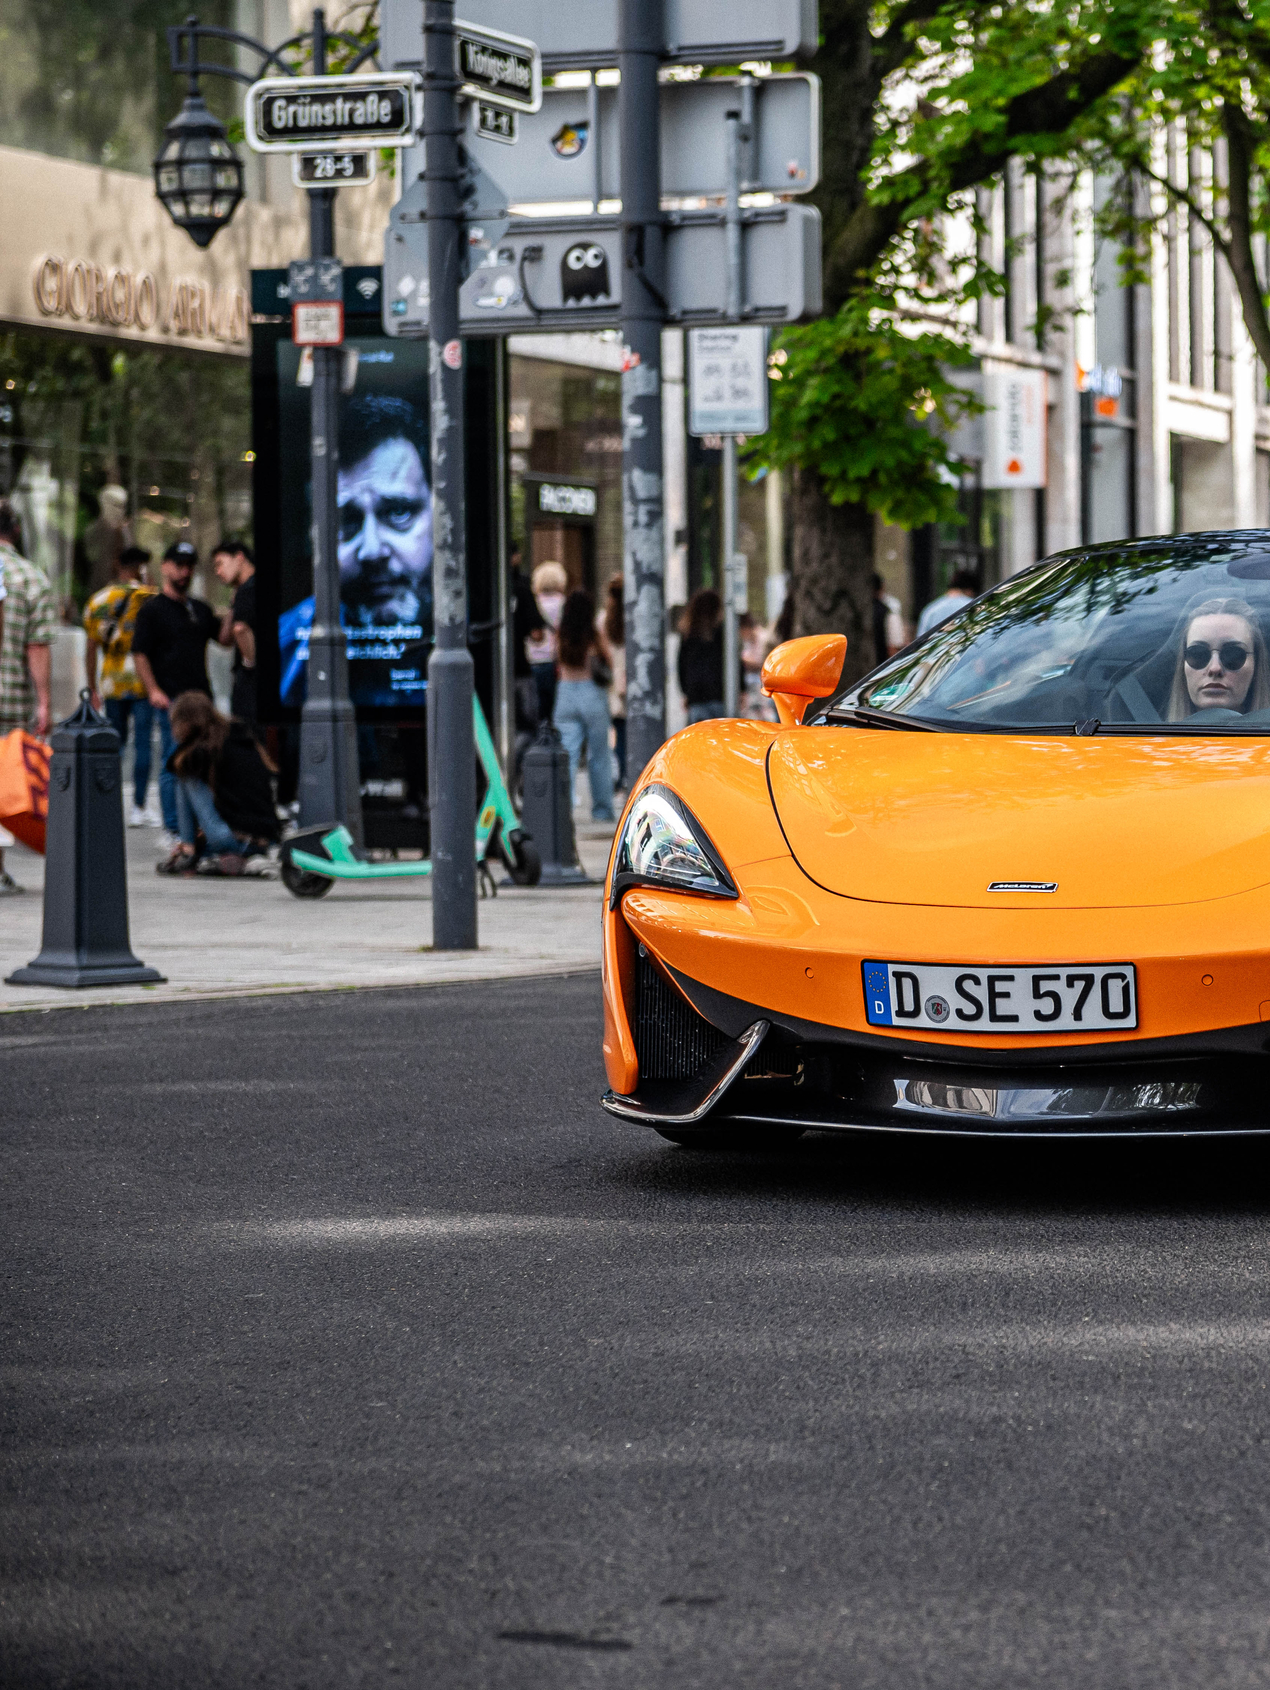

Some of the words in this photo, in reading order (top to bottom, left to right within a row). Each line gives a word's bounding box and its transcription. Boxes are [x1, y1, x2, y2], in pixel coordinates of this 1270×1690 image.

[271, 92, 392, 129] Grünstraße
[33, 254, 157, 331] GIORGIO
[874, 1000, 885, 1014] D
[892, 970, 921, 1018] D
[954, 973, 1019, 1022] SE
[1032, 972, 1131, 1022] 570
